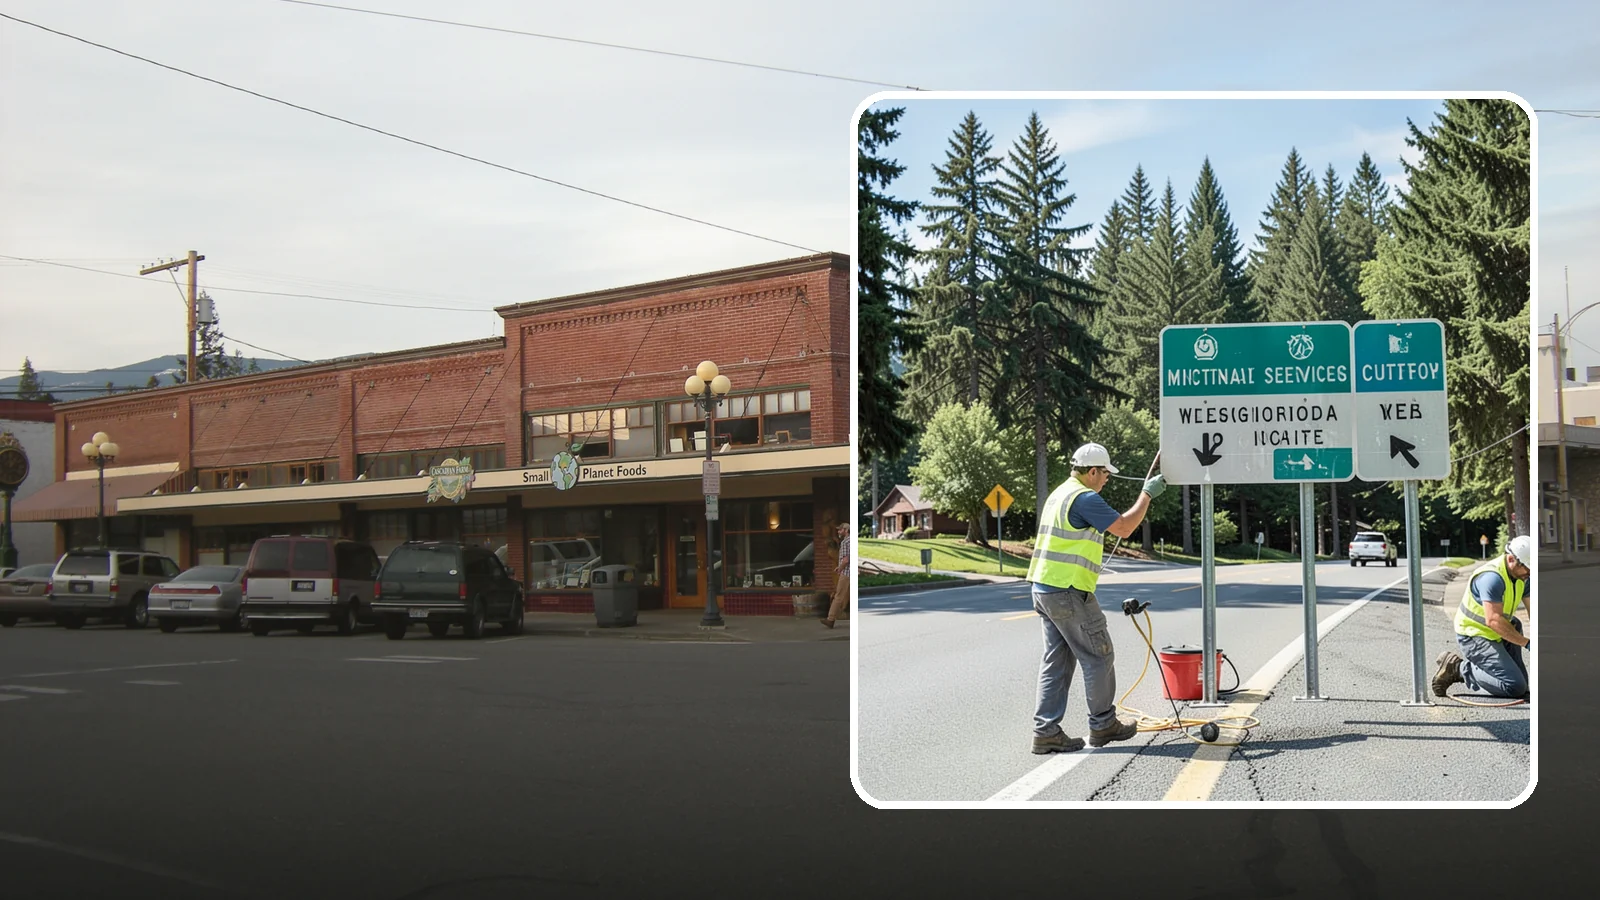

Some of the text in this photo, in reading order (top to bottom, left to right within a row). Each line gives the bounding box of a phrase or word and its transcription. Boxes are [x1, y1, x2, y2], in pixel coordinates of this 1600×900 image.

[523, 464, 647, 483] Small Planet Foods
